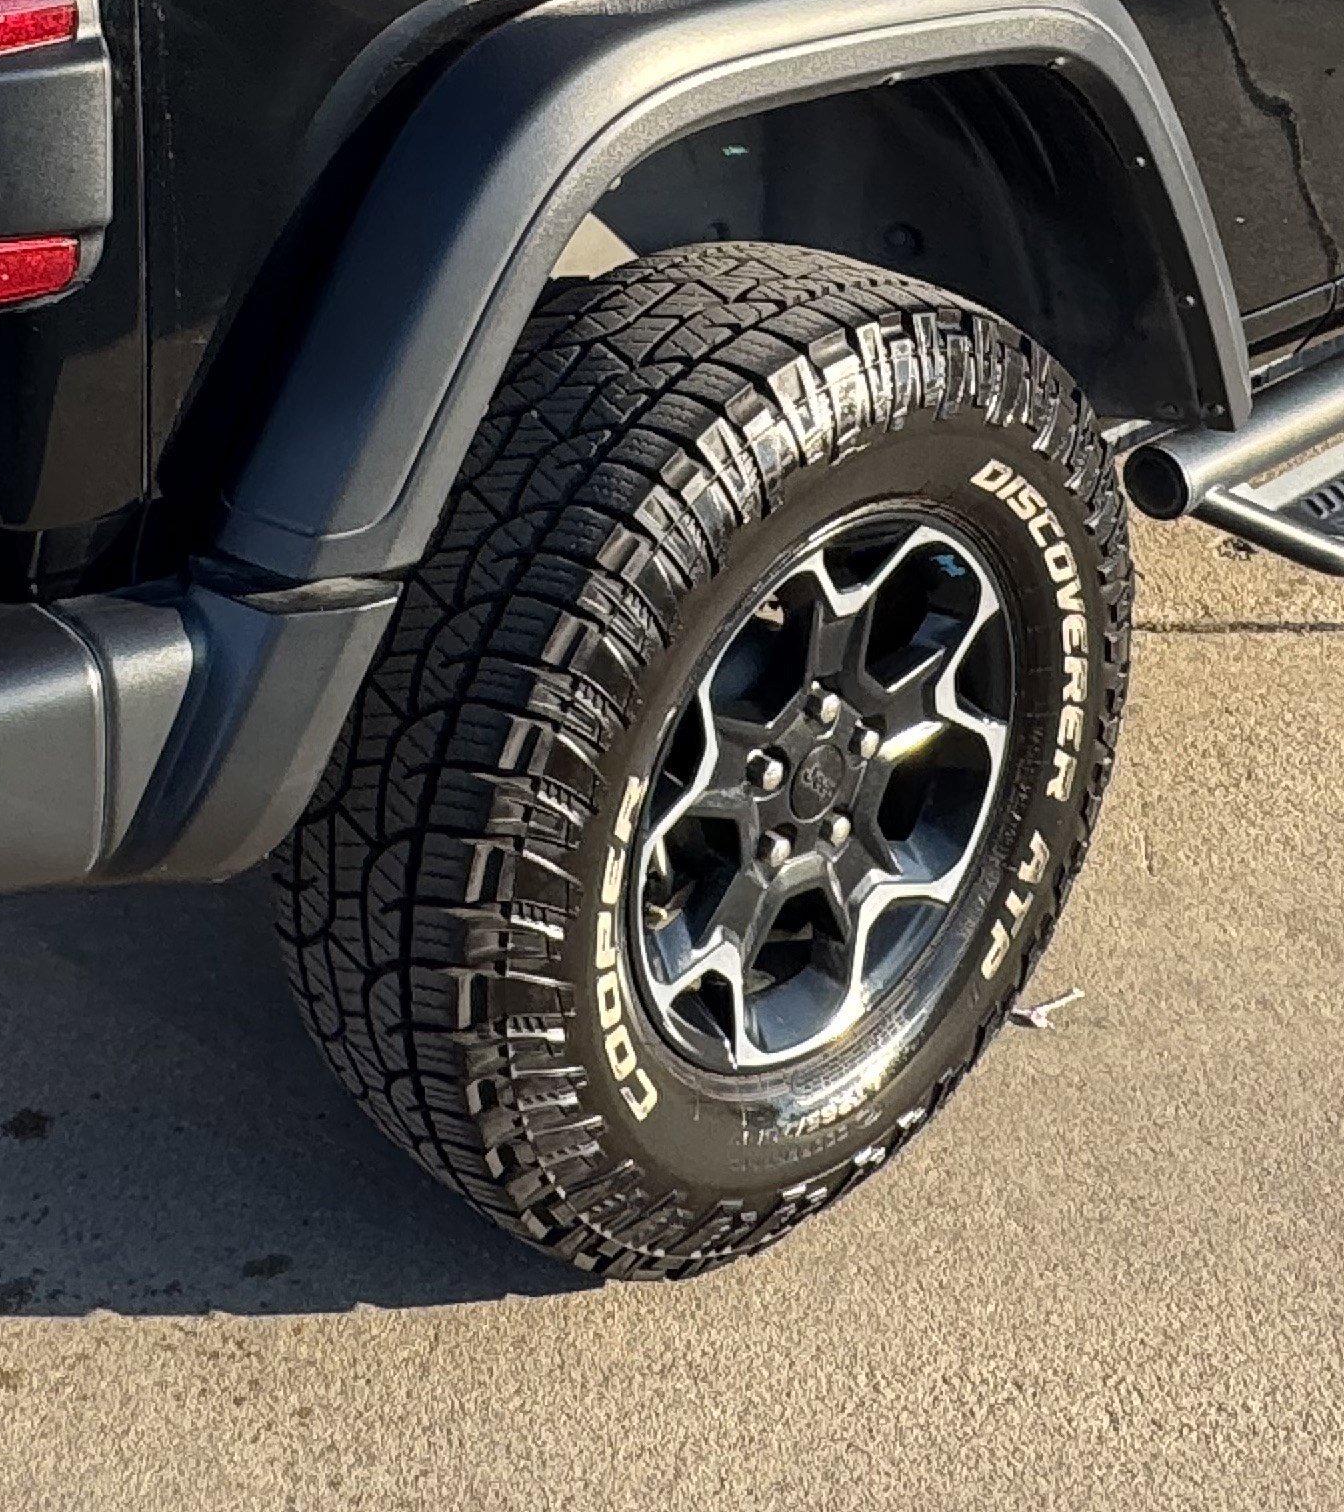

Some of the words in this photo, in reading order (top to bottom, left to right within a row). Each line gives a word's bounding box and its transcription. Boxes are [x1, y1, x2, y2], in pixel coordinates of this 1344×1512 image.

[970, 458, 1090, 803] DISCOVERER
[596, 776, 658, 1122] COOPER
[981, 829, 1051, 980] ATP
